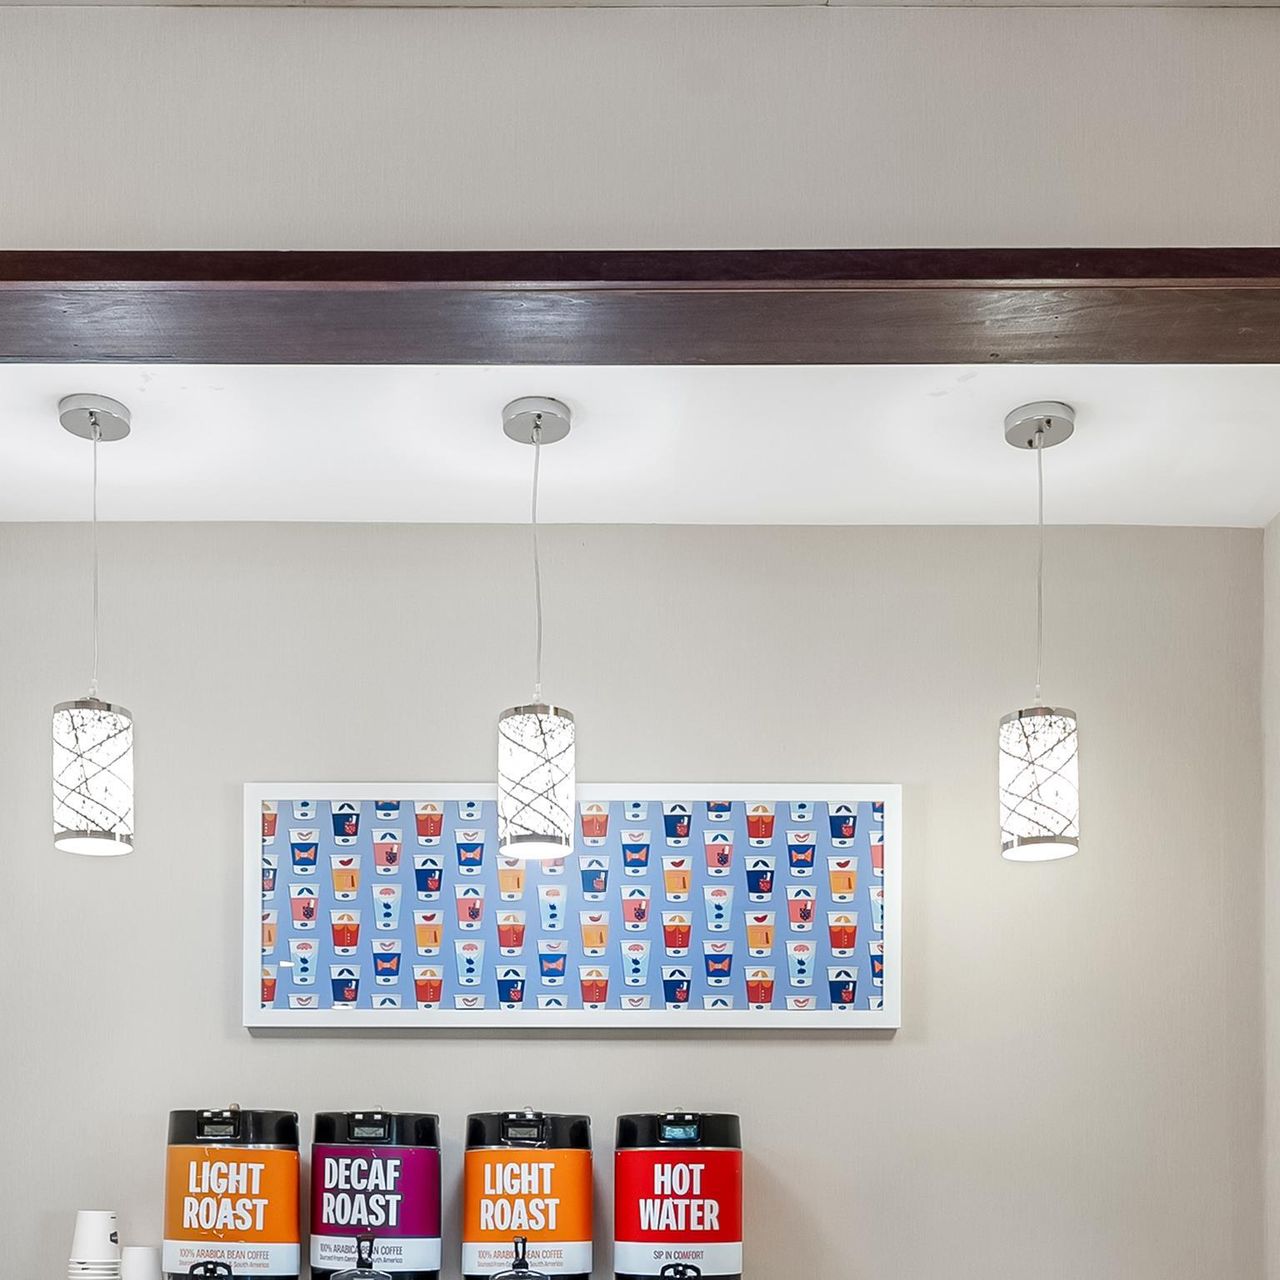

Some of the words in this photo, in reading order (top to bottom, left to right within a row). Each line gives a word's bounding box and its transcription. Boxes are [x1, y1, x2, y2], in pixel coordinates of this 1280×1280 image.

[189, 1161, 264, 1194] LIGHT
[324, 1158, 400, 1191] DECAF
[484, 1162, 555, 1195] LIGHT
[654, 1163, 705, 1195] HOT
[183, 1197, 268, 1230] ROAST
[322, 1193, 401, 1226] ROAST
[480, 1198, 560, 1230] ROAST
[639, 1199, 719, 1230] WATER
[195, 1248, 226, 1260] ARABICA
[226, 1250, 246, 1260] BEAN
[246, 1250, 270, 1260] COFFEE
[380, 1245, 403, 1256] COFFEE
[541, 1248, 564, 1260] COFFEE
[653, 1250, 665, 1260] SIP
[664, 1250, 673, 1260] IN
[673, 1250, 705, 1260] COMFORT
